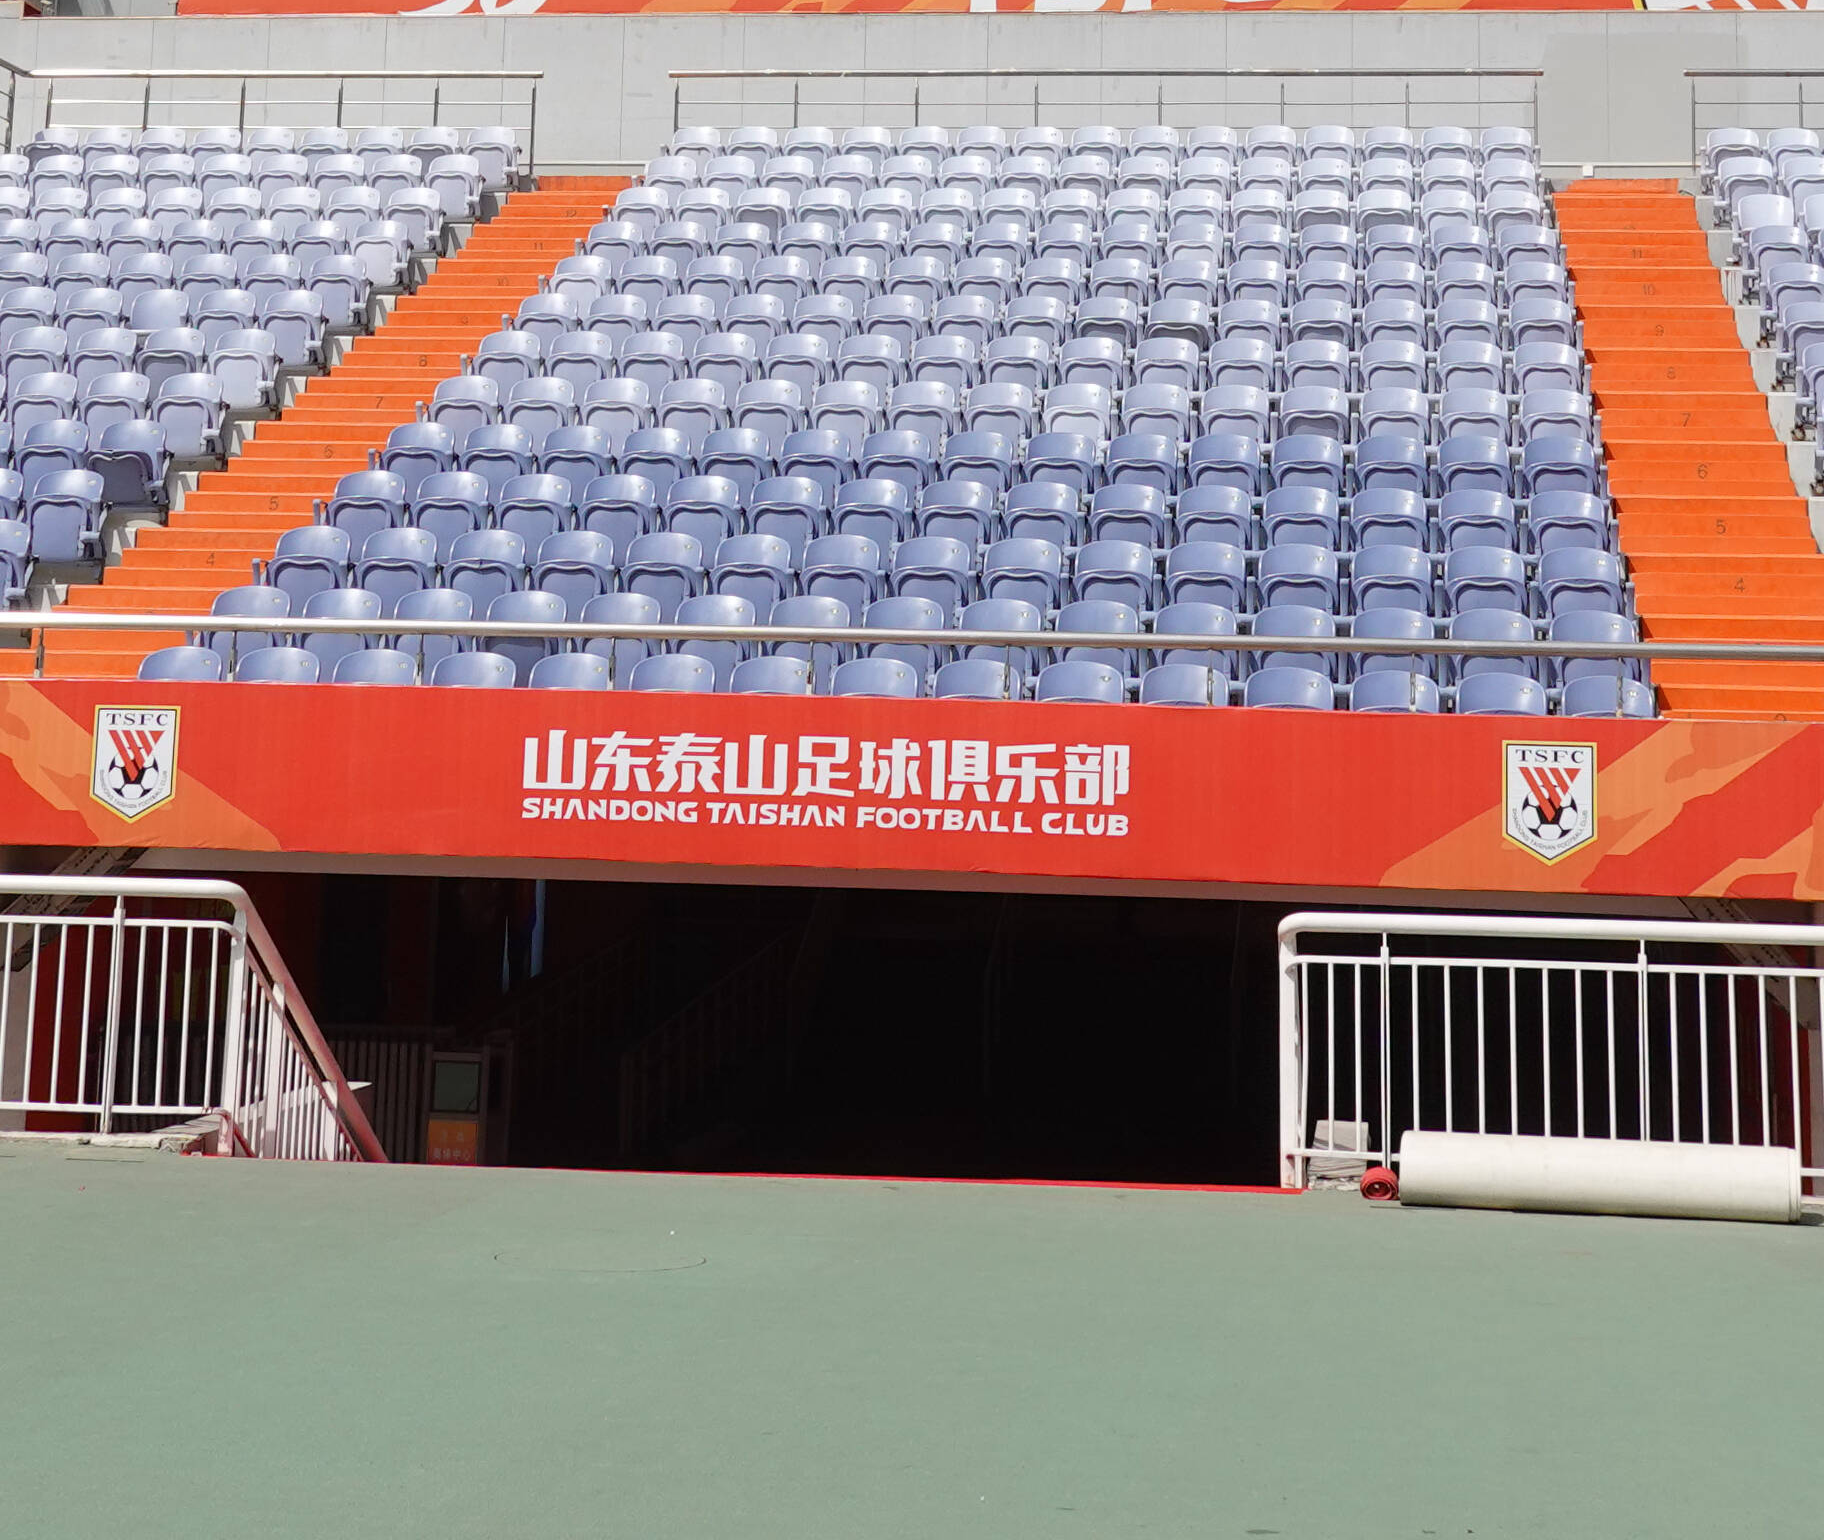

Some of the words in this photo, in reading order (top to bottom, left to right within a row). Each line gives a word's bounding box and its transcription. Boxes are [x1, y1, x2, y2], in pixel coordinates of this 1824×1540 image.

[1632, 249, 1643, 259] 11
[1643, 284, 1656, 296] 10
[1655, 324, 1665, 336] 9
[374, 396, 384, 409] 7
[1681, 412, 1692, 427] 7
[1697, 463, 1709, 479] 6
[1715, 519, 1727, 535] 5
[205, 552, 216, 567] 4
[1734, 577, 1746, 593] 4
[106, 712, 169, 727] TSFC
[1515, 748, 1585, 764] TSFC
[522, 729, 1130, 807] 山东泰山足球俱乐部
[521, 797, 699, 824] SHANDONG
[705, 801, 846, 828] TAISHAN
[855, 806, 1033, 834] FOOTBALL
[1040, 812, 1129, 837] CLUB
